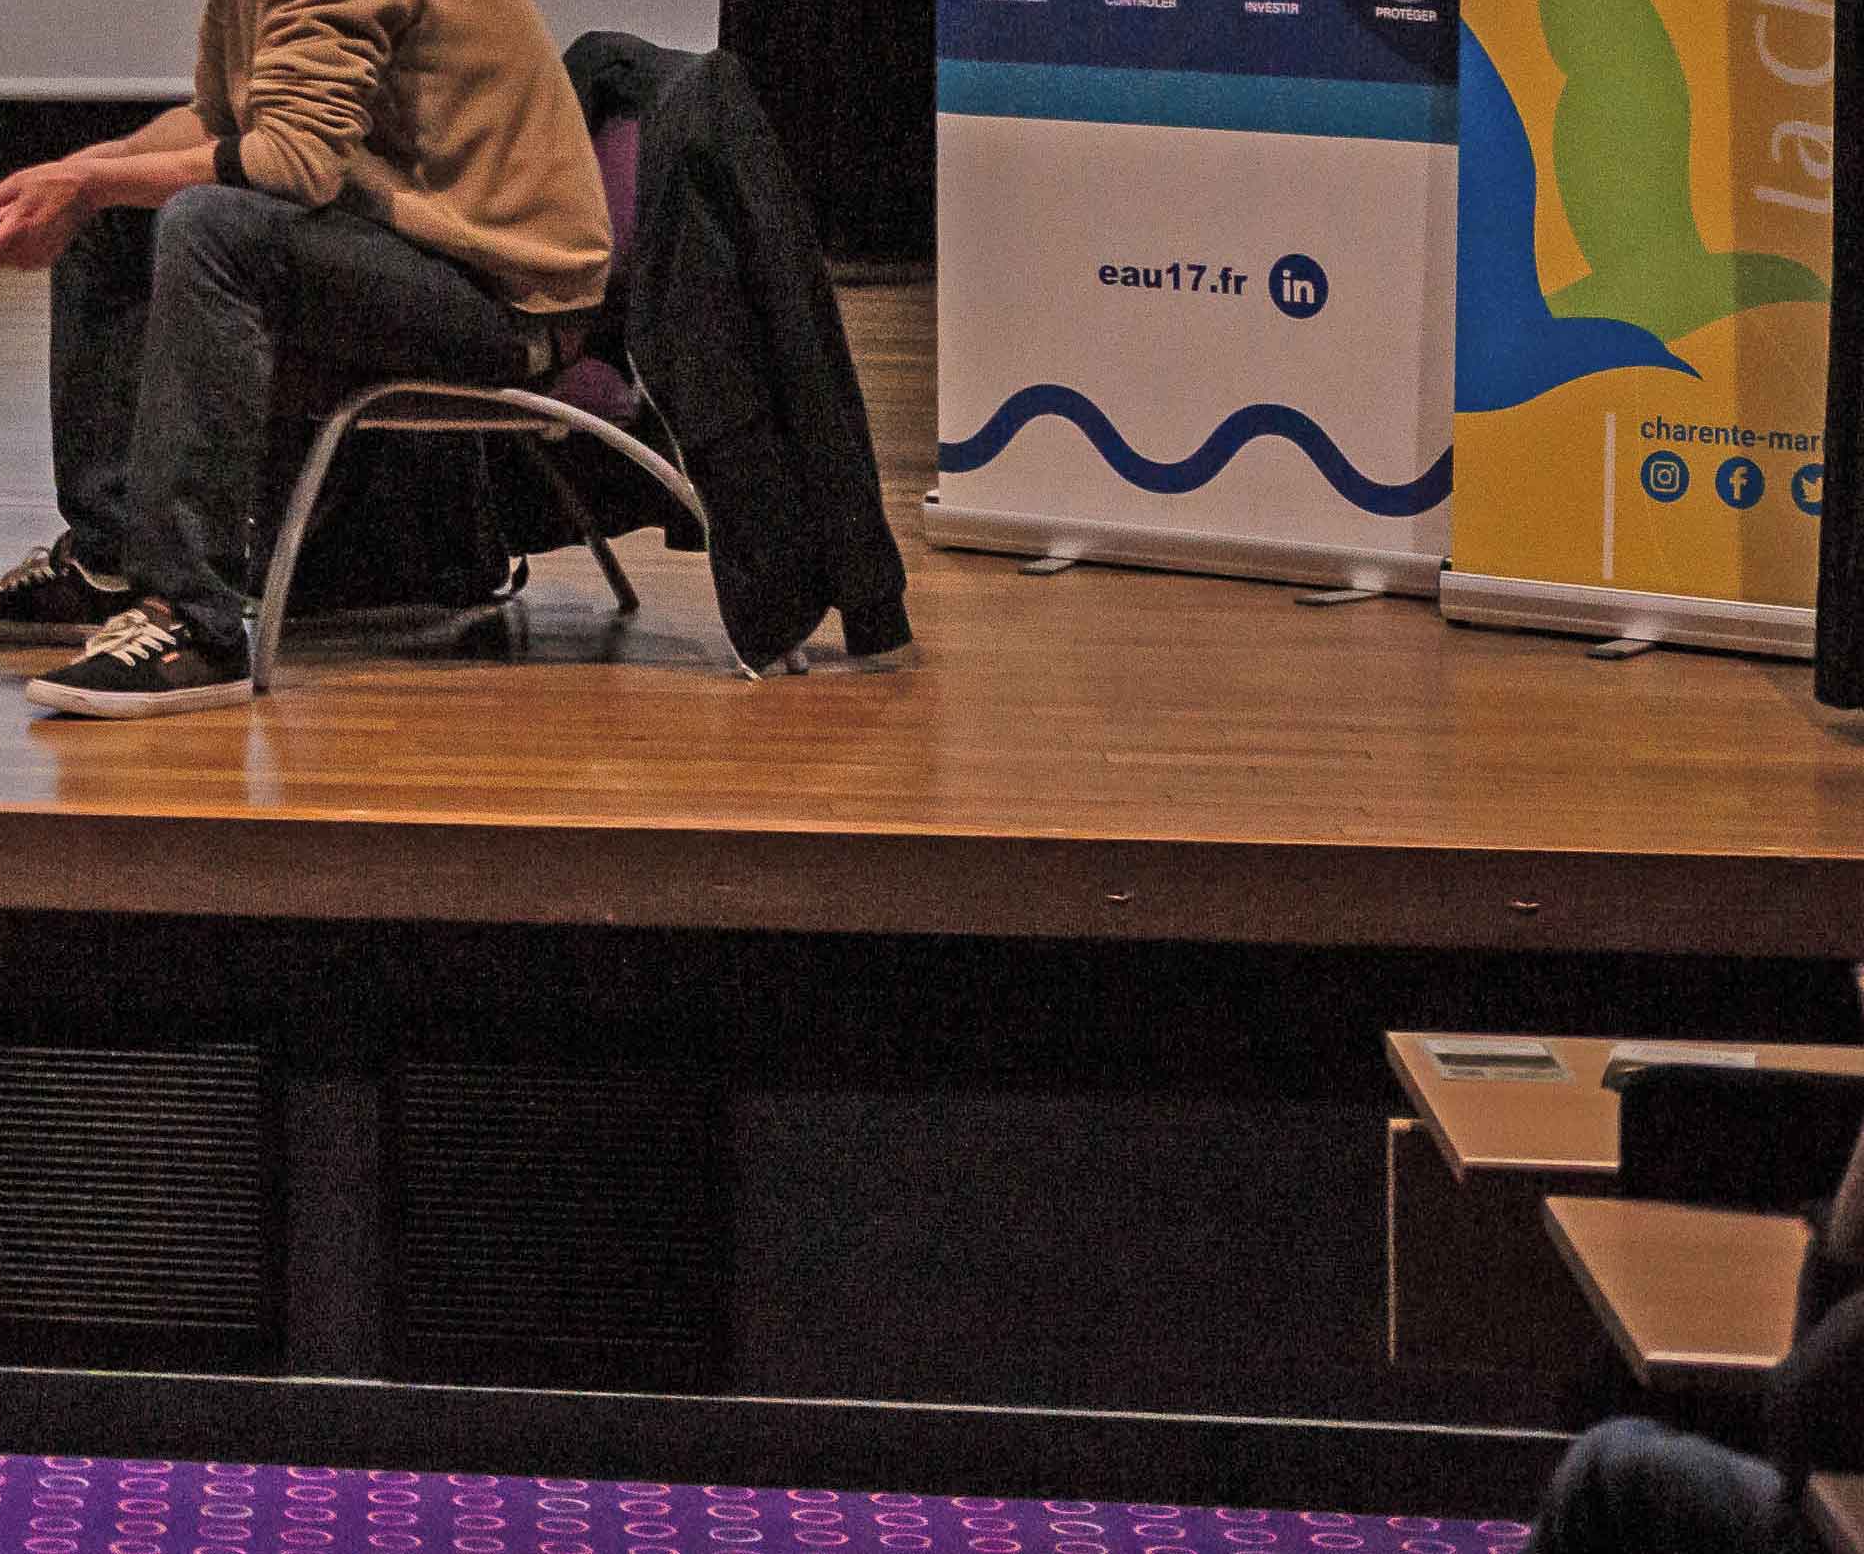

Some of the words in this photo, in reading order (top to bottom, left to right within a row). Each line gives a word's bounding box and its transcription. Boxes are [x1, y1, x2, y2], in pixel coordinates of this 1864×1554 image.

[1245, 1, 1300, 14] INVESTIR
[1754, 122, 1834, 215] la
[1099, 261, 1248, 295] eau17.fr
[1641, 414, 1825, 452] charente-mar
